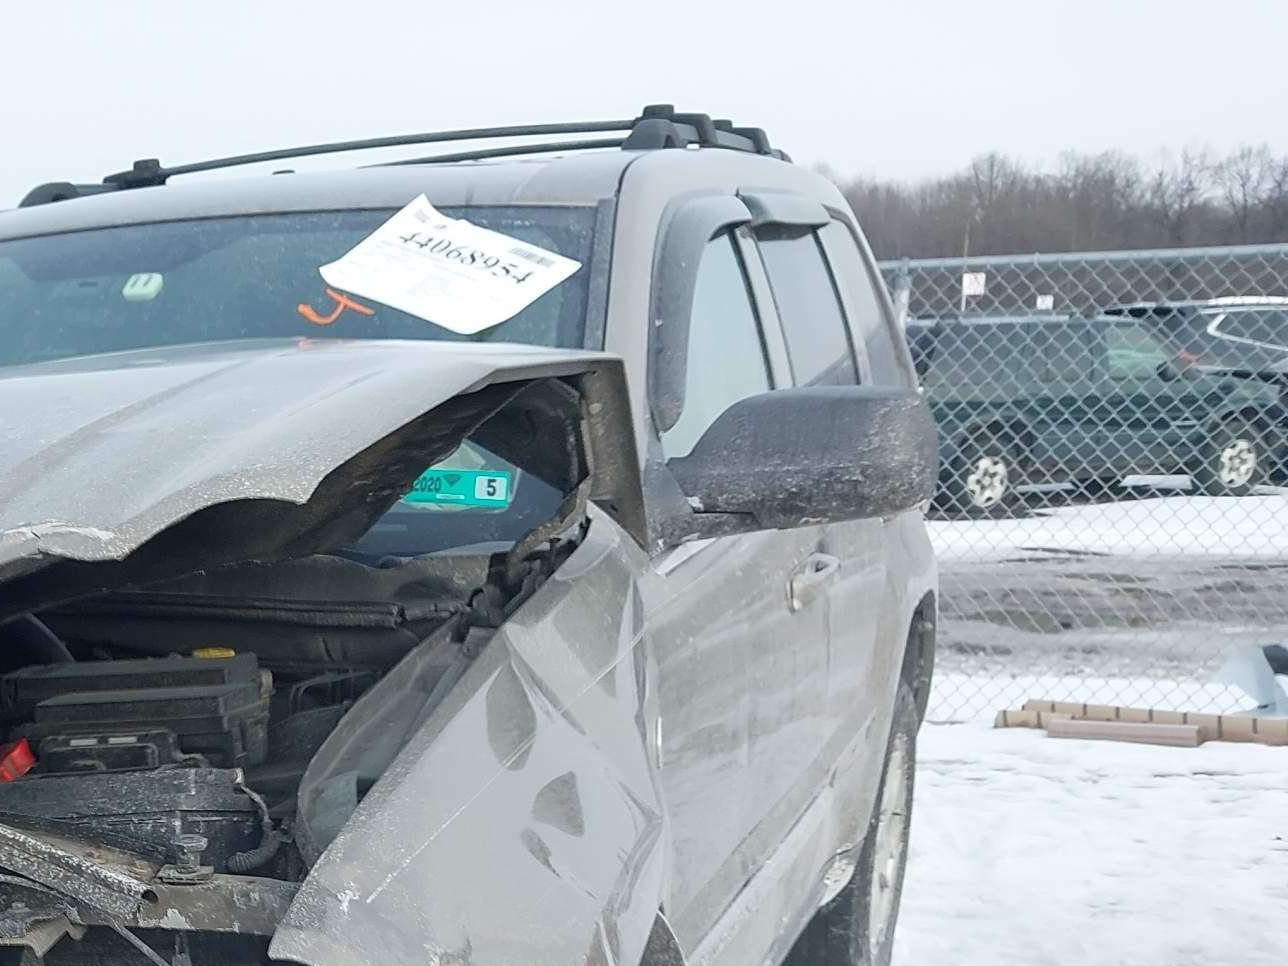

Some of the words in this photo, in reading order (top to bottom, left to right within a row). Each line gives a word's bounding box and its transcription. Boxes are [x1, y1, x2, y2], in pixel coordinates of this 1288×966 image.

[399, 231, 535, 285] 44068954
[412, 475, 442, 493] 2020
[486, 478, 497, 497] 5
